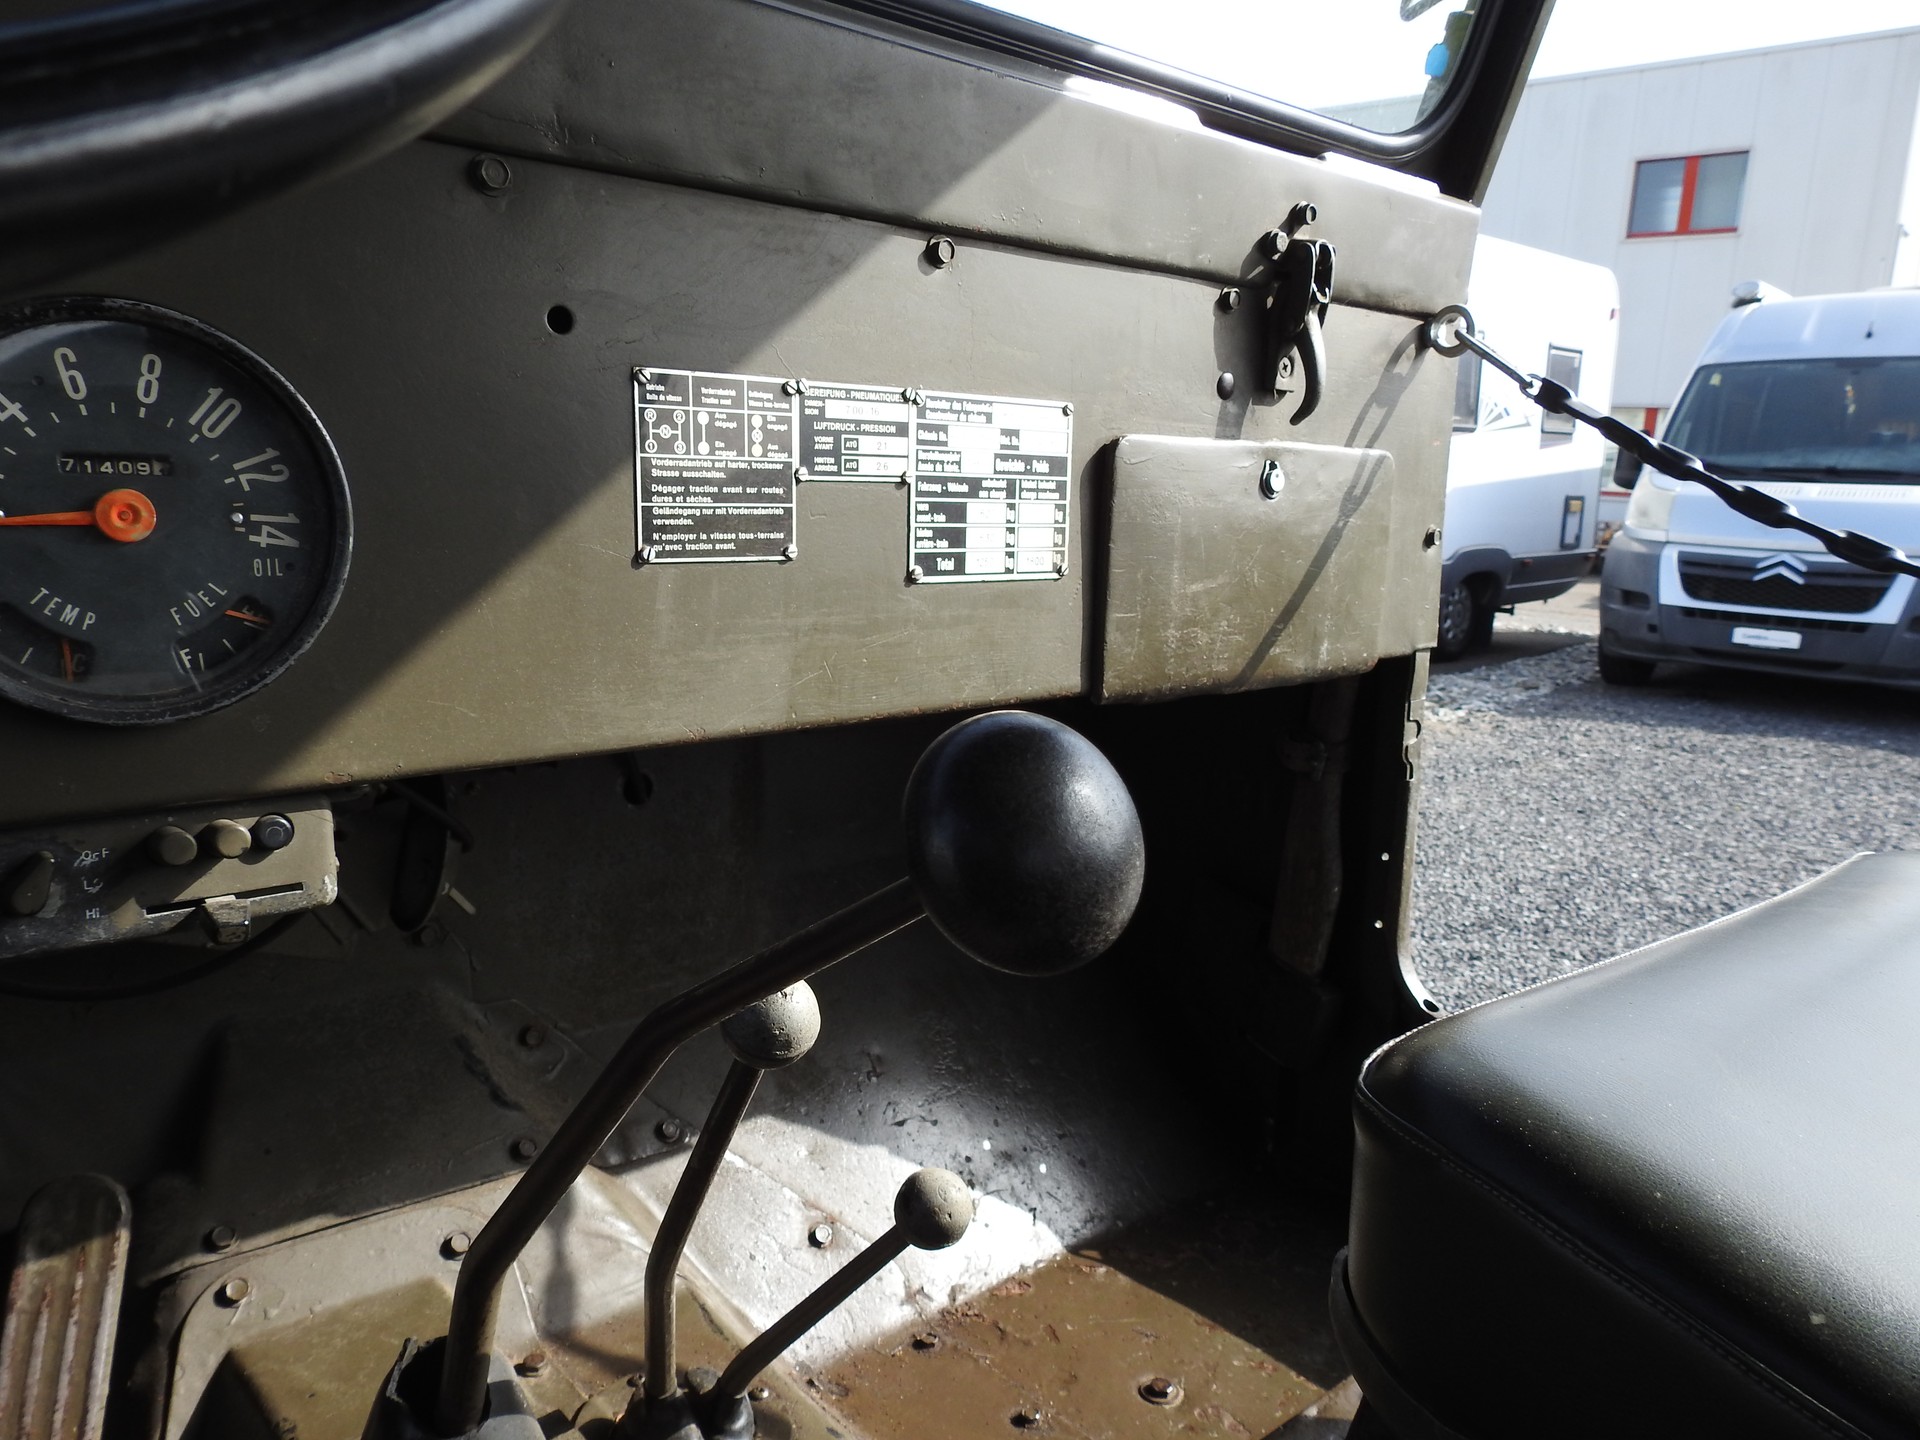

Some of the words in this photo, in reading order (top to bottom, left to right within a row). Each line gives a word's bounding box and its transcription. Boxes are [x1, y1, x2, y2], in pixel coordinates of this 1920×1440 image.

[53, 347, 88, 400] 6
[137, 354, 162, 404] 8
[188, 387, 242, 439] 10
[814, 421, 856, 432] LUFTDRUCK
[860, 424, 896, 434] PRESSION
[233, 447, 290, 491] 12
[651, 458, 713, 468] Vorderradantrieb
[714, 460, 727, 468] auf
[727, 461, 750, 470] harter,
[752, 461, 783, 470] trockener
[651, 469, 680, 478] Strasse
[651, 484, 685, 494] Dégager
[689, 485, 719, 493] traction
[722, 486, 743, 494] avant
[652, 495, 673, 503] dures
[675, 495, 684, 503] et
[652, 507, 701, 516] Geländegang
[715, 507, 727, 515] mit
[728, 507, 784, 515] Vorderradantrieb
[652, 518, 694, 526] verwenden.
[249, 513, 300, 548] 14
[653, 532, 697, 542] N'employer
[700, 532, 707, 540] la
[710, 532, 736, 540] vitesse
[739, 532, 784, 540] tous-terrains
[652, 543, 683, 552] qu'avec
[685, 542, 713, 551] traction
[715, 542, 737, 550] avant.
[253, 558, 283, 576] OIL
[29, 587, 96, 631] TEMP
[170, 582, 228, 626] FUEL
[180, 648, 192, 669] F
[85, 907, 100, 919] Hi
